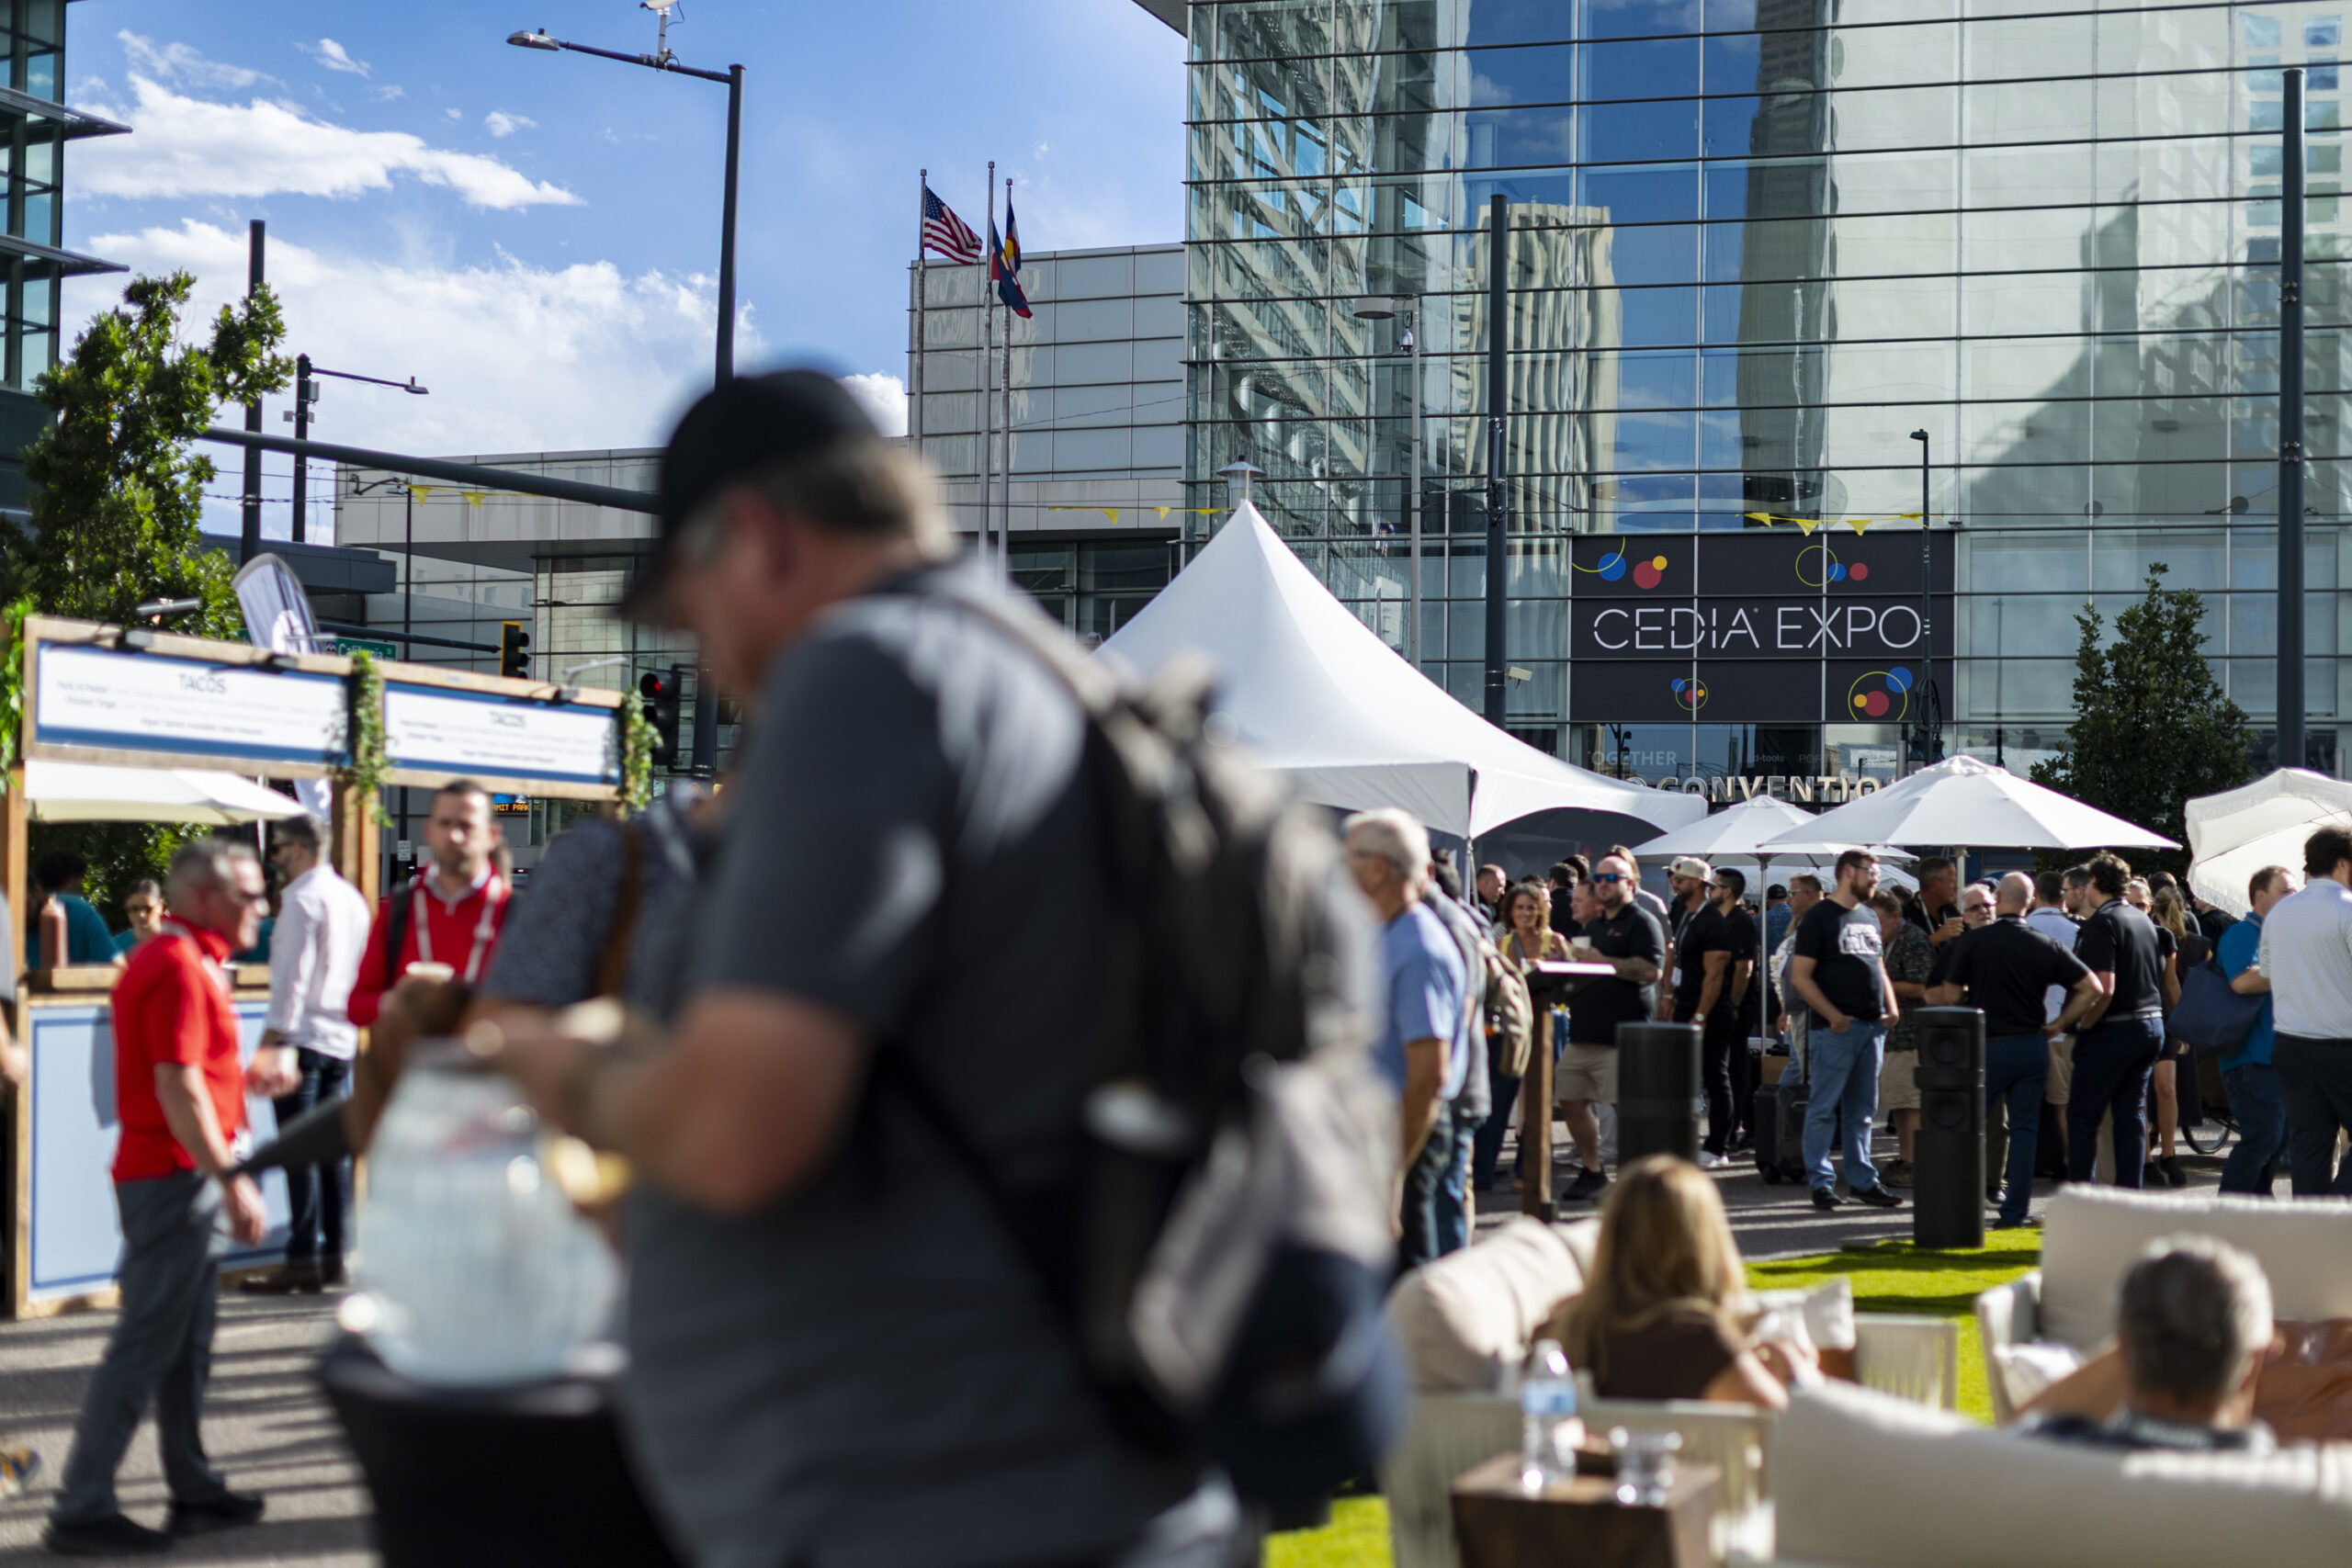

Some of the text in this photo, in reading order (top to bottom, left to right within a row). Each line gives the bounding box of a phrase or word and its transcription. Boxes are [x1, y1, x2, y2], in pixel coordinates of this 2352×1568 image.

[1594, 604, 1922, 649] CEDIA EXPO
[178, 674, 227, 694] TACOS
[1588, 750, 1678, 766] OGETHER
[1656, 775, 1898, 803] CONVENTIO
